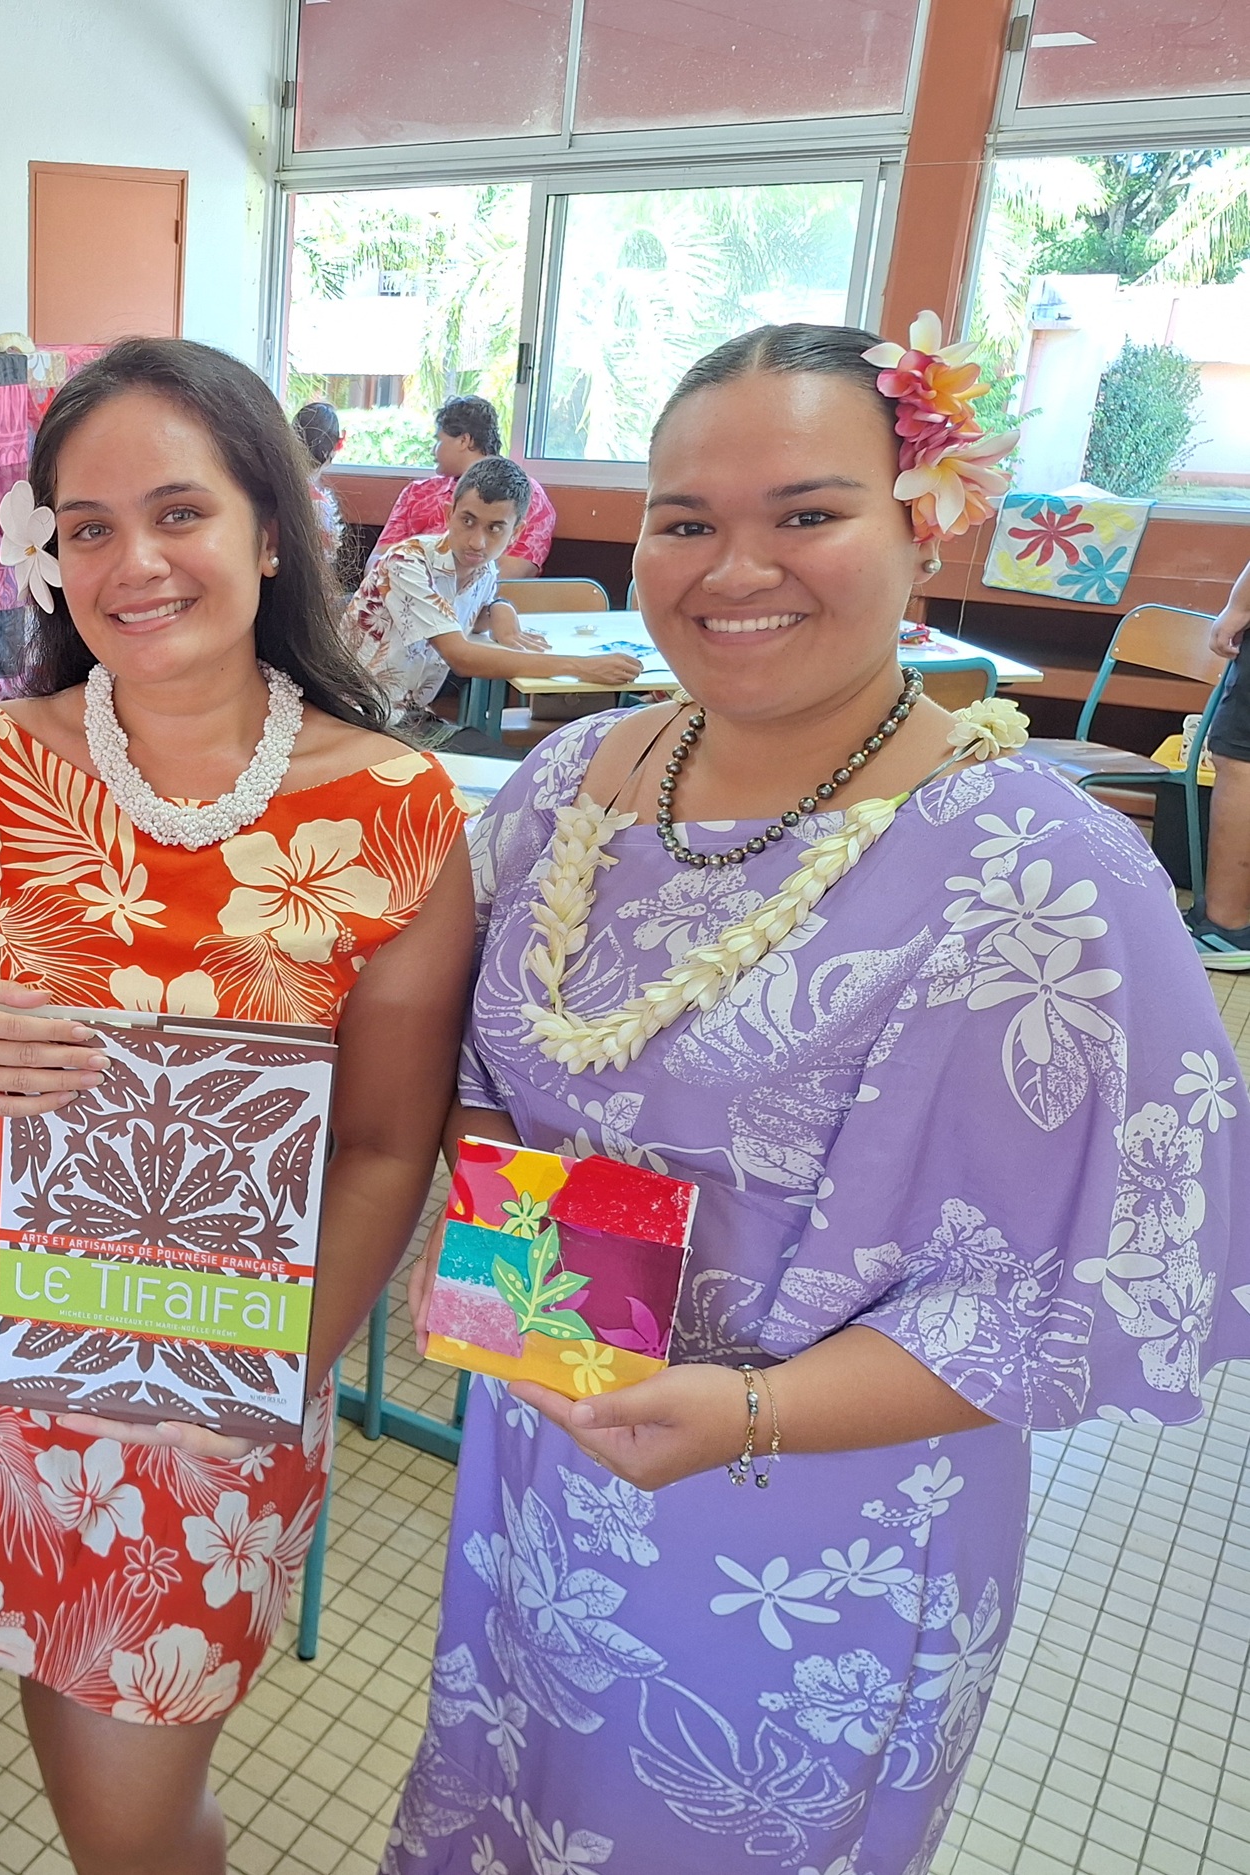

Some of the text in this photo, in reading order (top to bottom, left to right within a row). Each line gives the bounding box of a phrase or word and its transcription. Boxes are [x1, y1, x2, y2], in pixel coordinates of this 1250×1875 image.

[21, 1232, 49, 1245] ARTS
[52, 1236, 66, 1247] ET
[68, 1238, 135, 1256] ARTISANATS
[138, 1246, 154, 1257] DE
[222, 1256, 286, 1274] FRANÇAISE
[15, 1261, 72, 1305] LE
[59, 1308, 239, 1338] MICHÈLE DE CHAZEAUX ET MARIE-NOËLLE FRÉMY
